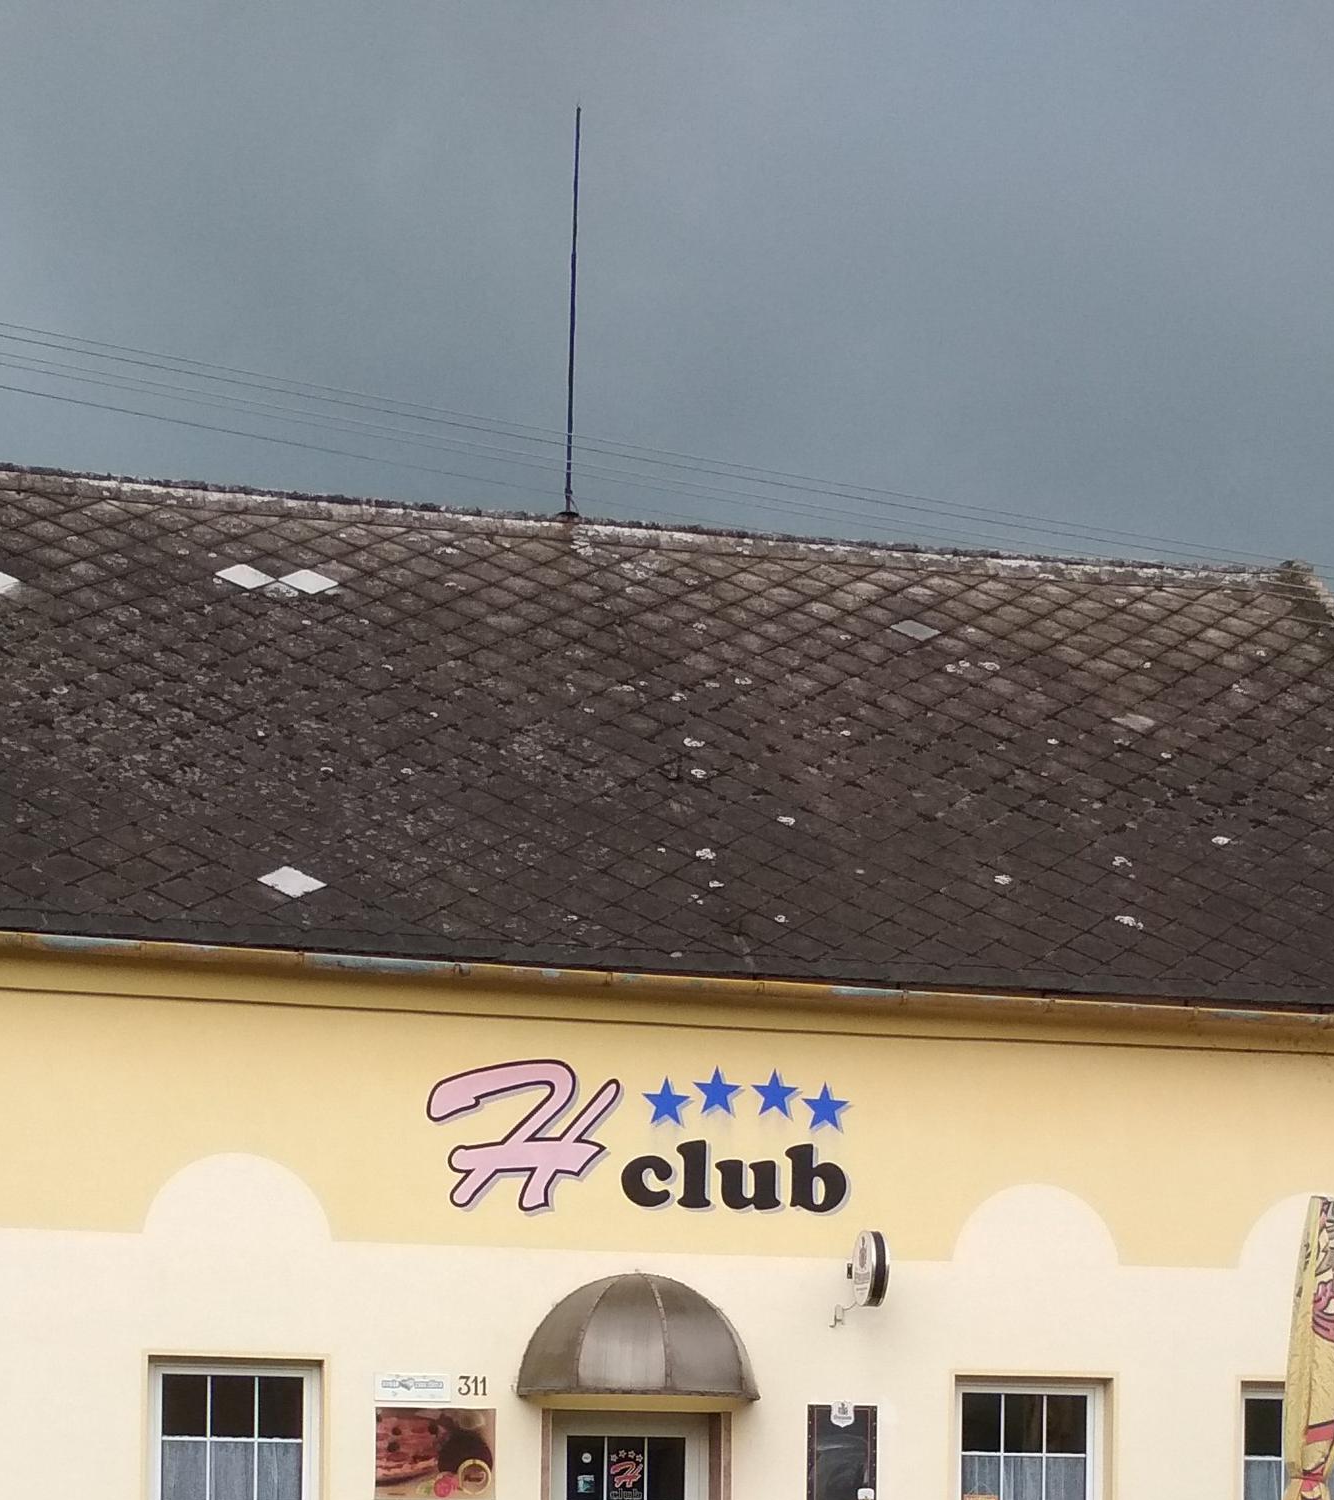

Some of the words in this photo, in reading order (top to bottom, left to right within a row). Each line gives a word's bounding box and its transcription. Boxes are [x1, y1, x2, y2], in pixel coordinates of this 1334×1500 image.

[426, 1058, 621, 1211] H
[620, 1139, 848, 1213] club
[457, 1375, 487, 1396] 311
[610, 1488, 643, 1500] club
